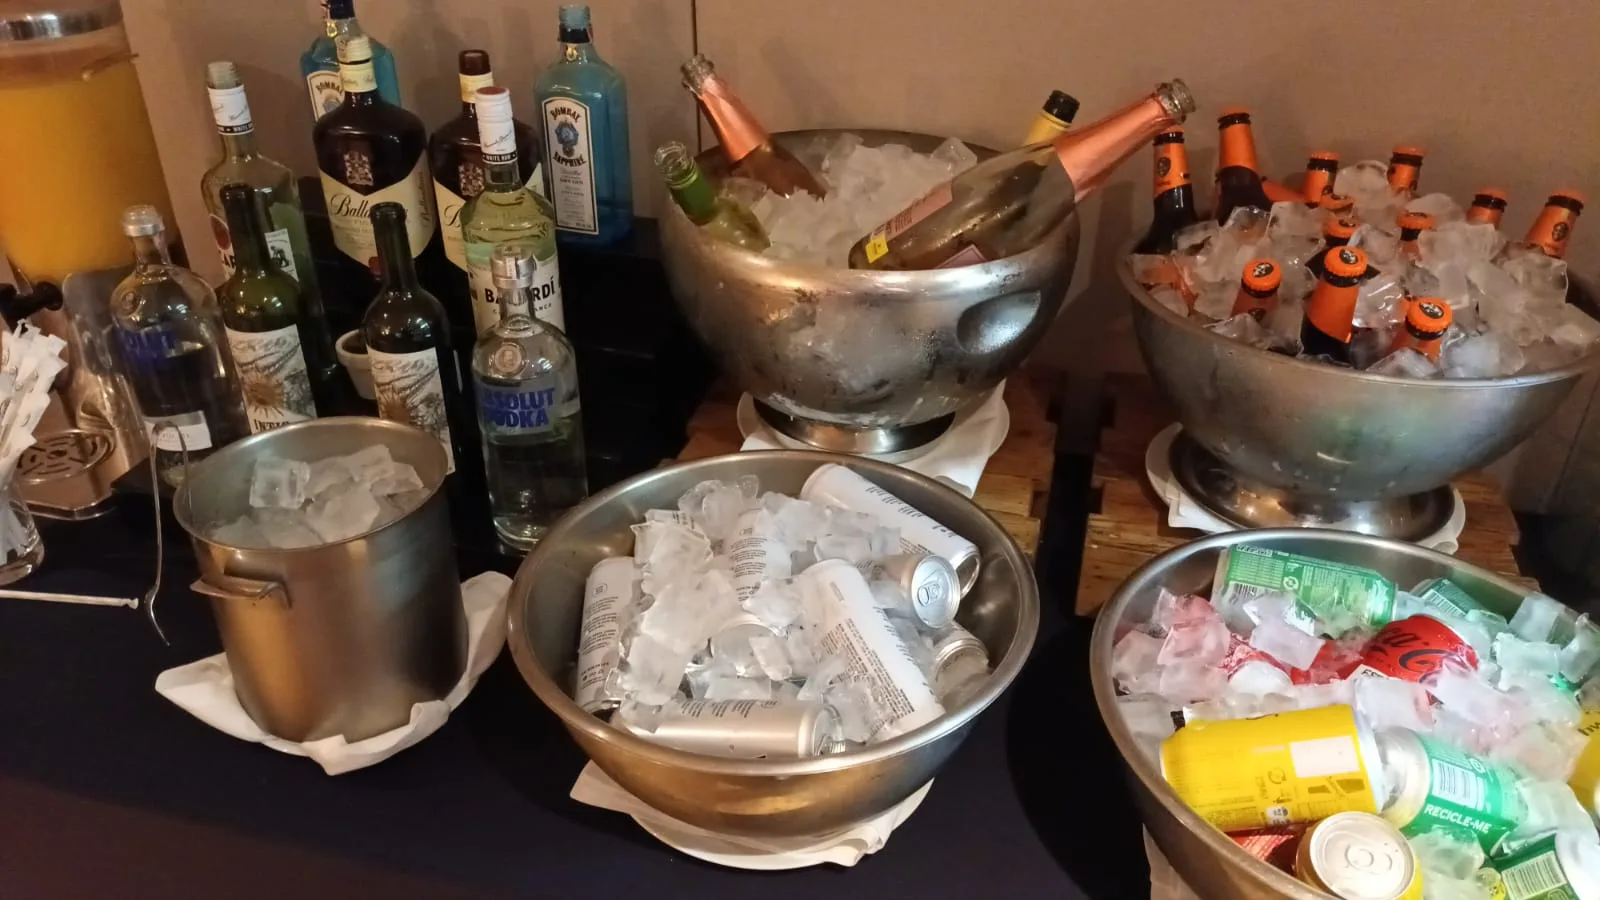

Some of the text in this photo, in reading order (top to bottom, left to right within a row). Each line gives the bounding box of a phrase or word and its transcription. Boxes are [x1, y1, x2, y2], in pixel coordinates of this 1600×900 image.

[550, 106, 582, 123] BOMBAY
[552, 151, 587, 167] SAPPHIRE
[484, 276, 556, 305] BRDÍ
[1423, 803, 1492, 834] RECICLE-ME
